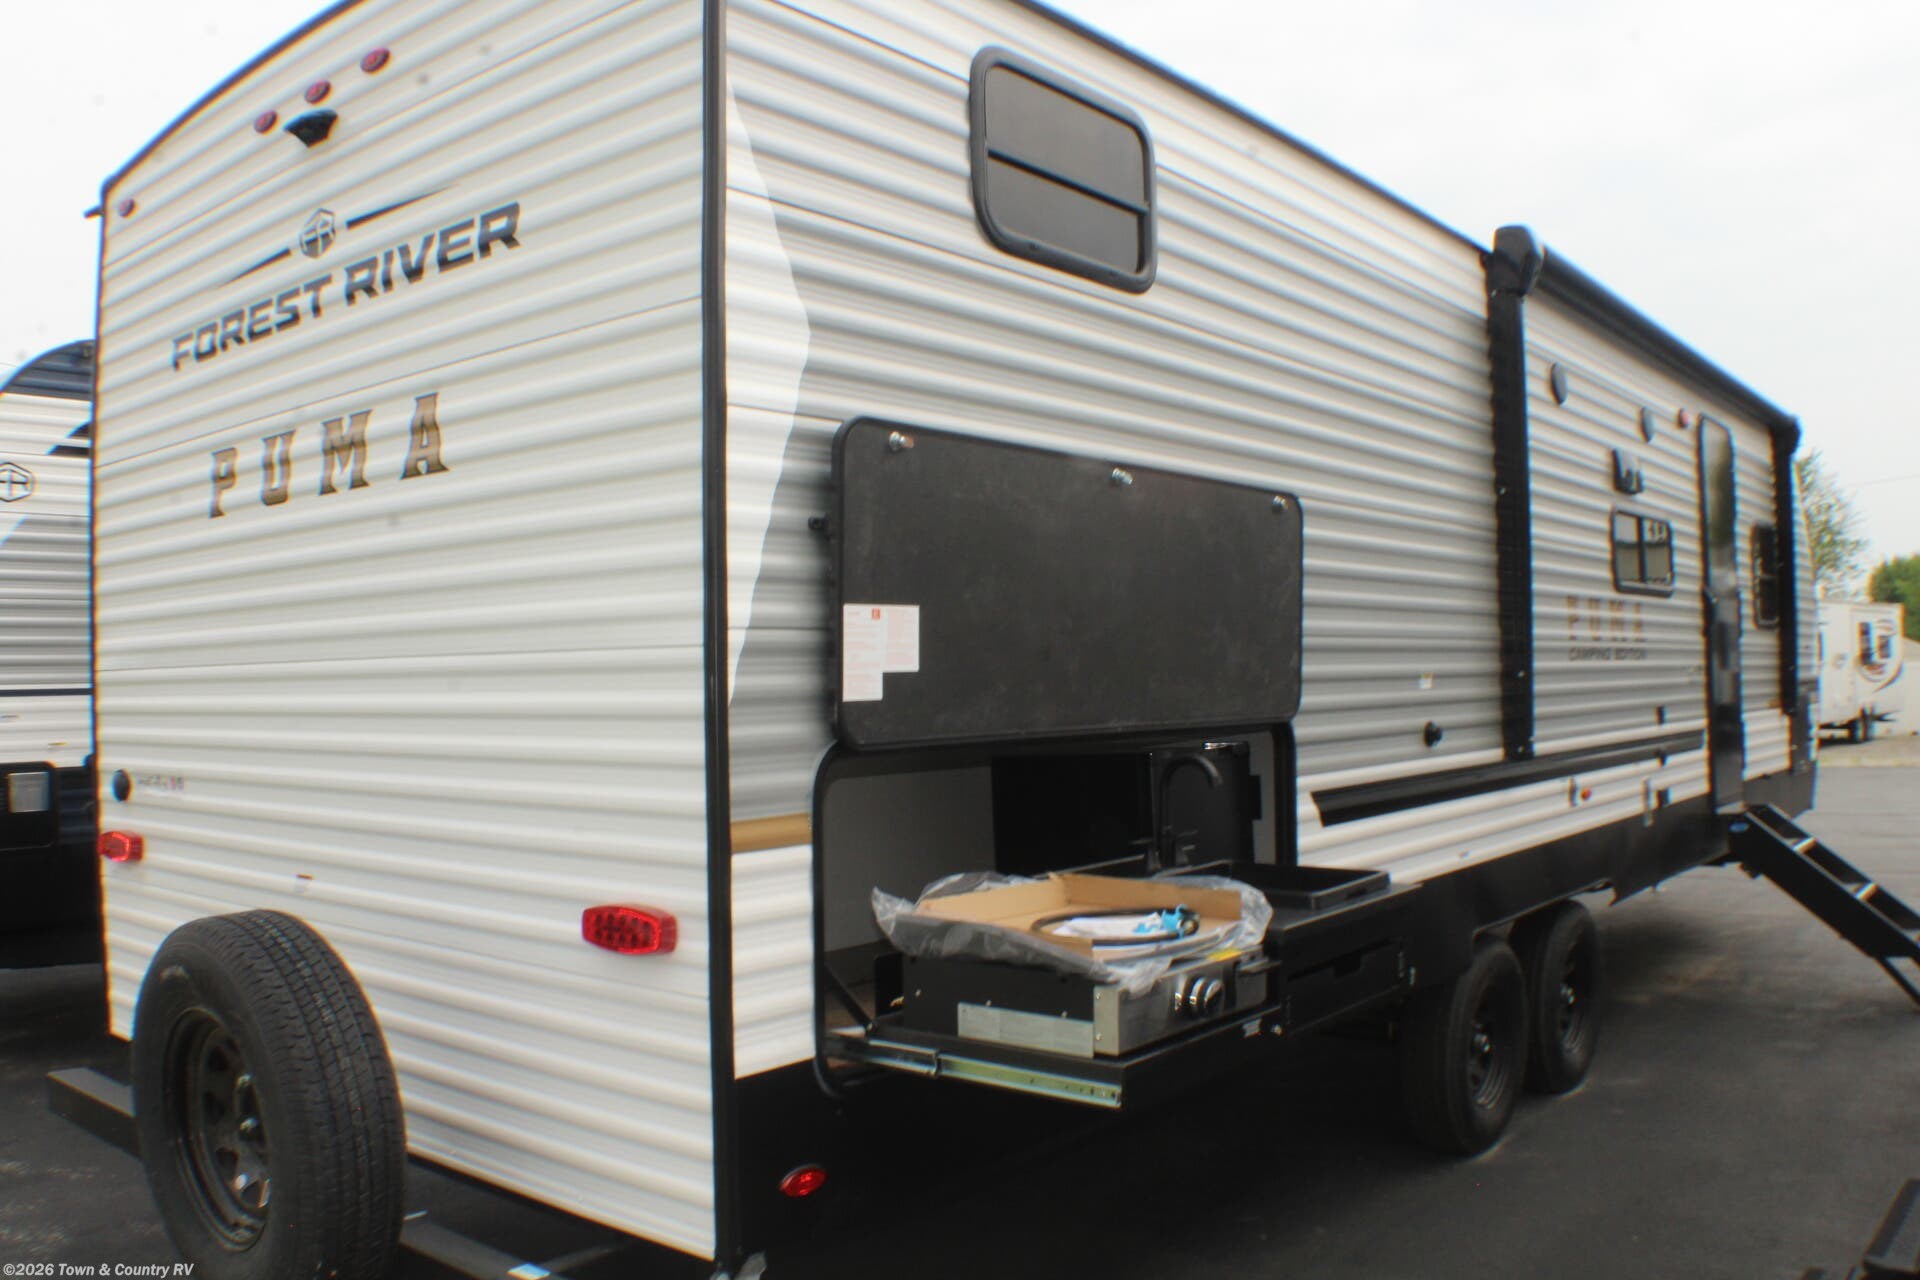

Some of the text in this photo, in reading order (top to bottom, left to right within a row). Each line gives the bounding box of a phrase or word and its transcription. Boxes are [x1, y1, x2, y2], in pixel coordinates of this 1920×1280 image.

[171, 201, 521, 371] FOREST RIVER
[208, 391, 449, 519] PUMA
[1567, 595, 1647, 642] PUMA
